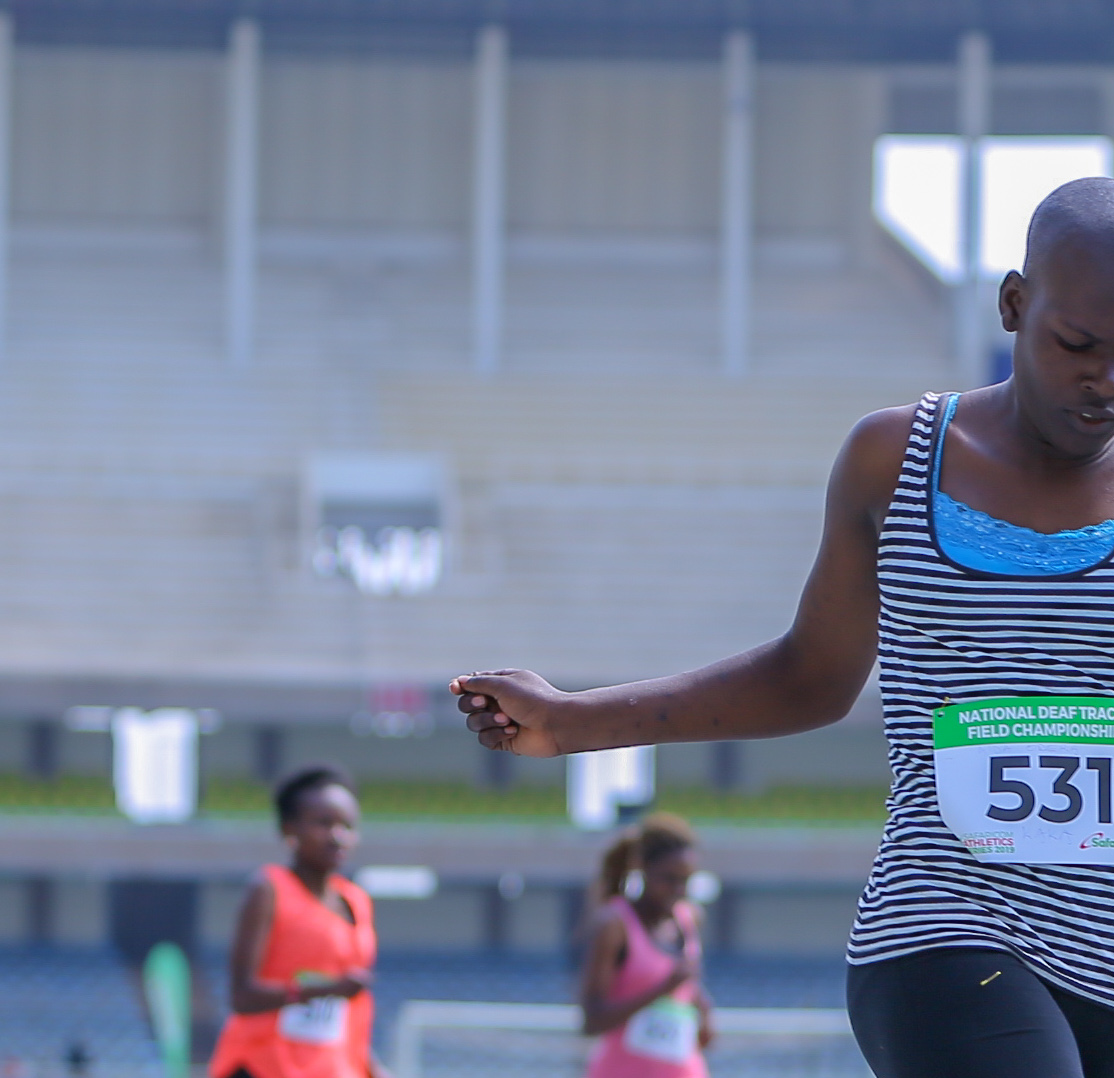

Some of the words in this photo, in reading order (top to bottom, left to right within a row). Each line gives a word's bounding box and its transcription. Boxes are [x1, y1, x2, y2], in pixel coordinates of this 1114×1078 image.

[958, 706, 1036, 724] NATIONAL
[1038, 705, 1077, 720] DEAF
[967, 724, 1011, 739] FIELD
[985, 755, 1113, 823] 531
[964, 838, 1014, 847] ATHLETICS
